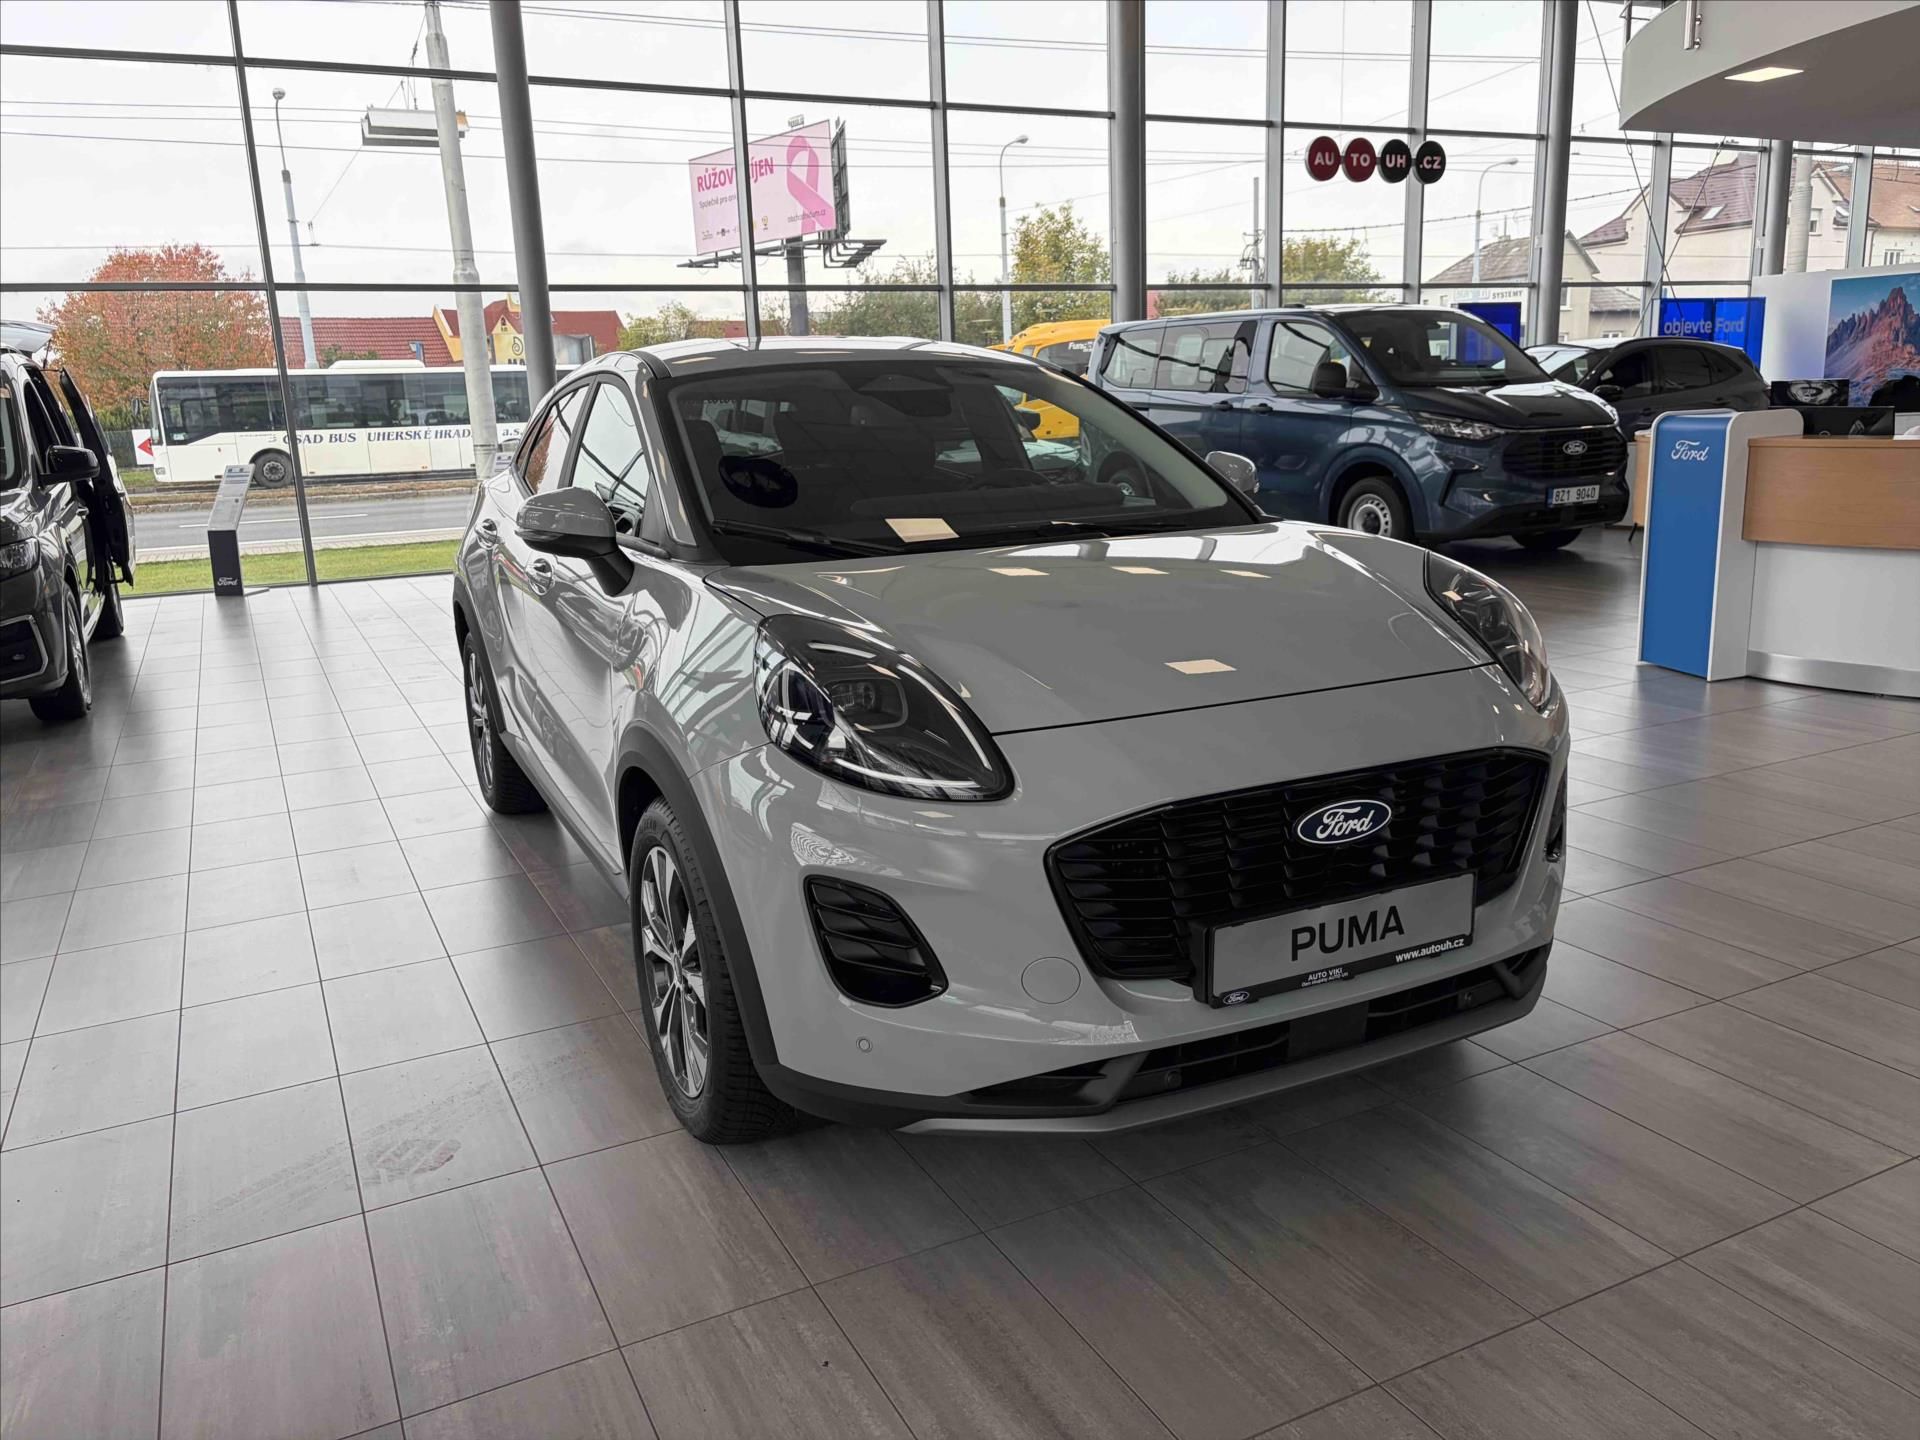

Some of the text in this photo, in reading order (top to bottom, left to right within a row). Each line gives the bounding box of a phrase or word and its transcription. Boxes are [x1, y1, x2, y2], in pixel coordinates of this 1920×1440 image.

[1313, 152, 1335, 166] AU
[1351, 153, 1371, 167] TO
[1385, 154, 1407, 168] UH
[696, 156, 774, 192] RŮŽOV ÍJEN
[1663, 317, 1745, 337] objevte Ford
[328, 432, 357, 443] BUS
[367, 428, 431, 442] UHERSKÉ
[434, 428, 472, 440] HRAD
[1671, 439, 1710, 462] Ford
[1554, 487, 1596, 502] 8Z1 9040
[217, 577, 239, 586] Ford
[1315, 805, 1376, 840] Ford
[1291, 905, 1405, 961] PUMA
[1395, 938, 1465, 963] www.autouh.cz
[1308, 967, 1343, 981] AUTO VIKI
